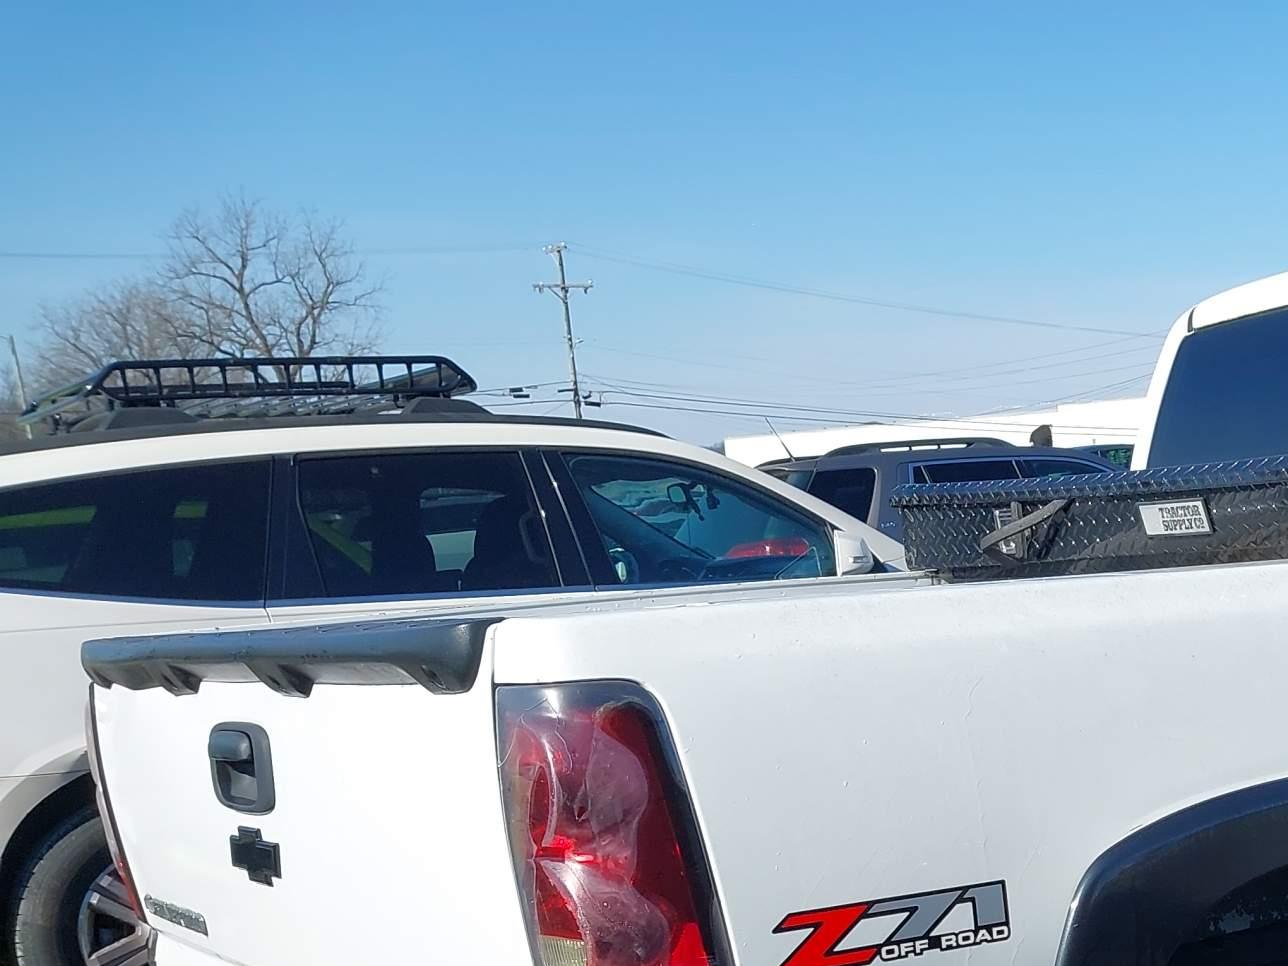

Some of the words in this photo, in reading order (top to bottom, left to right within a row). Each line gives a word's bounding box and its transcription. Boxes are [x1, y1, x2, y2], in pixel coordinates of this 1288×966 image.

[1158, 505, 1201, 518] TRACTOR
[1162, 518, 1194, 531] SUPPLY
[880, 939, 930, 961] OFF
[940, 925, 1010, 951] ROAD
